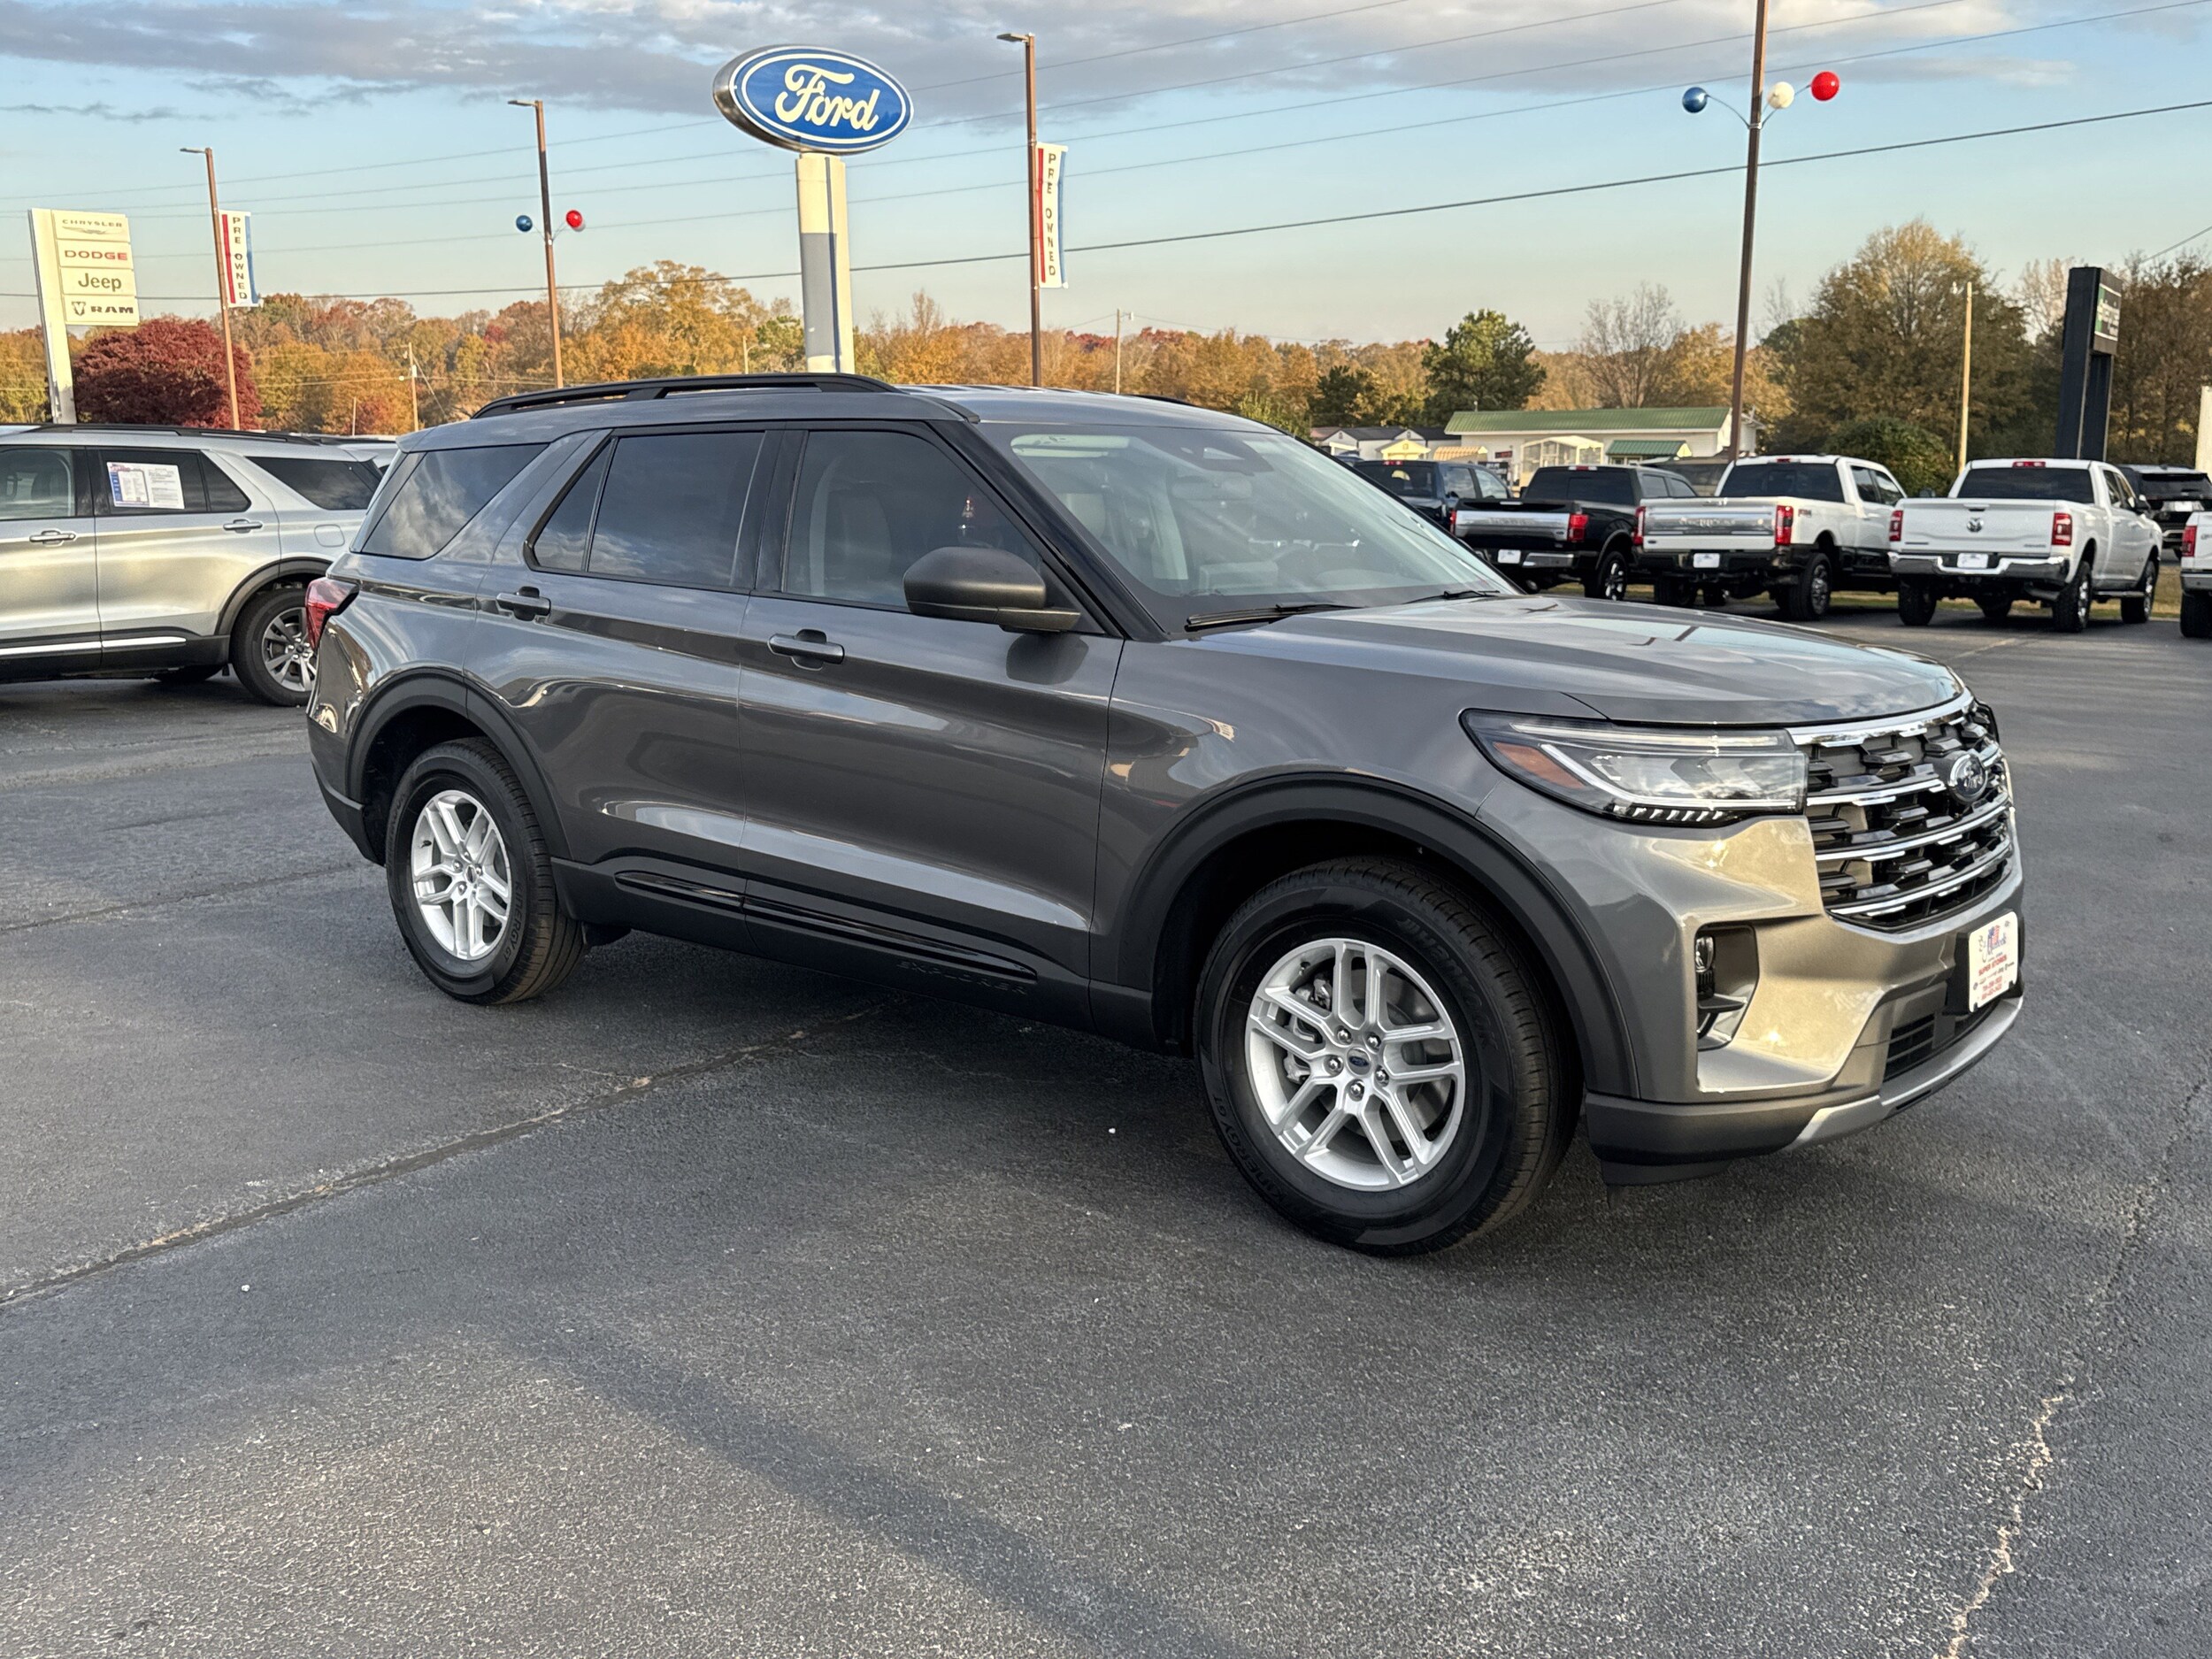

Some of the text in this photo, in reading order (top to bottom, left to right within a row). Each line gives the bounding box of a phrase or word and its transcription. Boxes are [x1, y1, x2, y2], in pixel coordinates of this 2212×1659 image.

[774, 64, 881, 132] Ford
[62, 219, 123, 227] CHRYSLER
[1045, 152, 1057, 277] PRE OWNED
[64, 250, 128, 261] DODGE
[232, 216, 248, 300] PRE OWNED
[77, 273, 122, 292] Jeep
[90, 305, 134, 314] RAM
